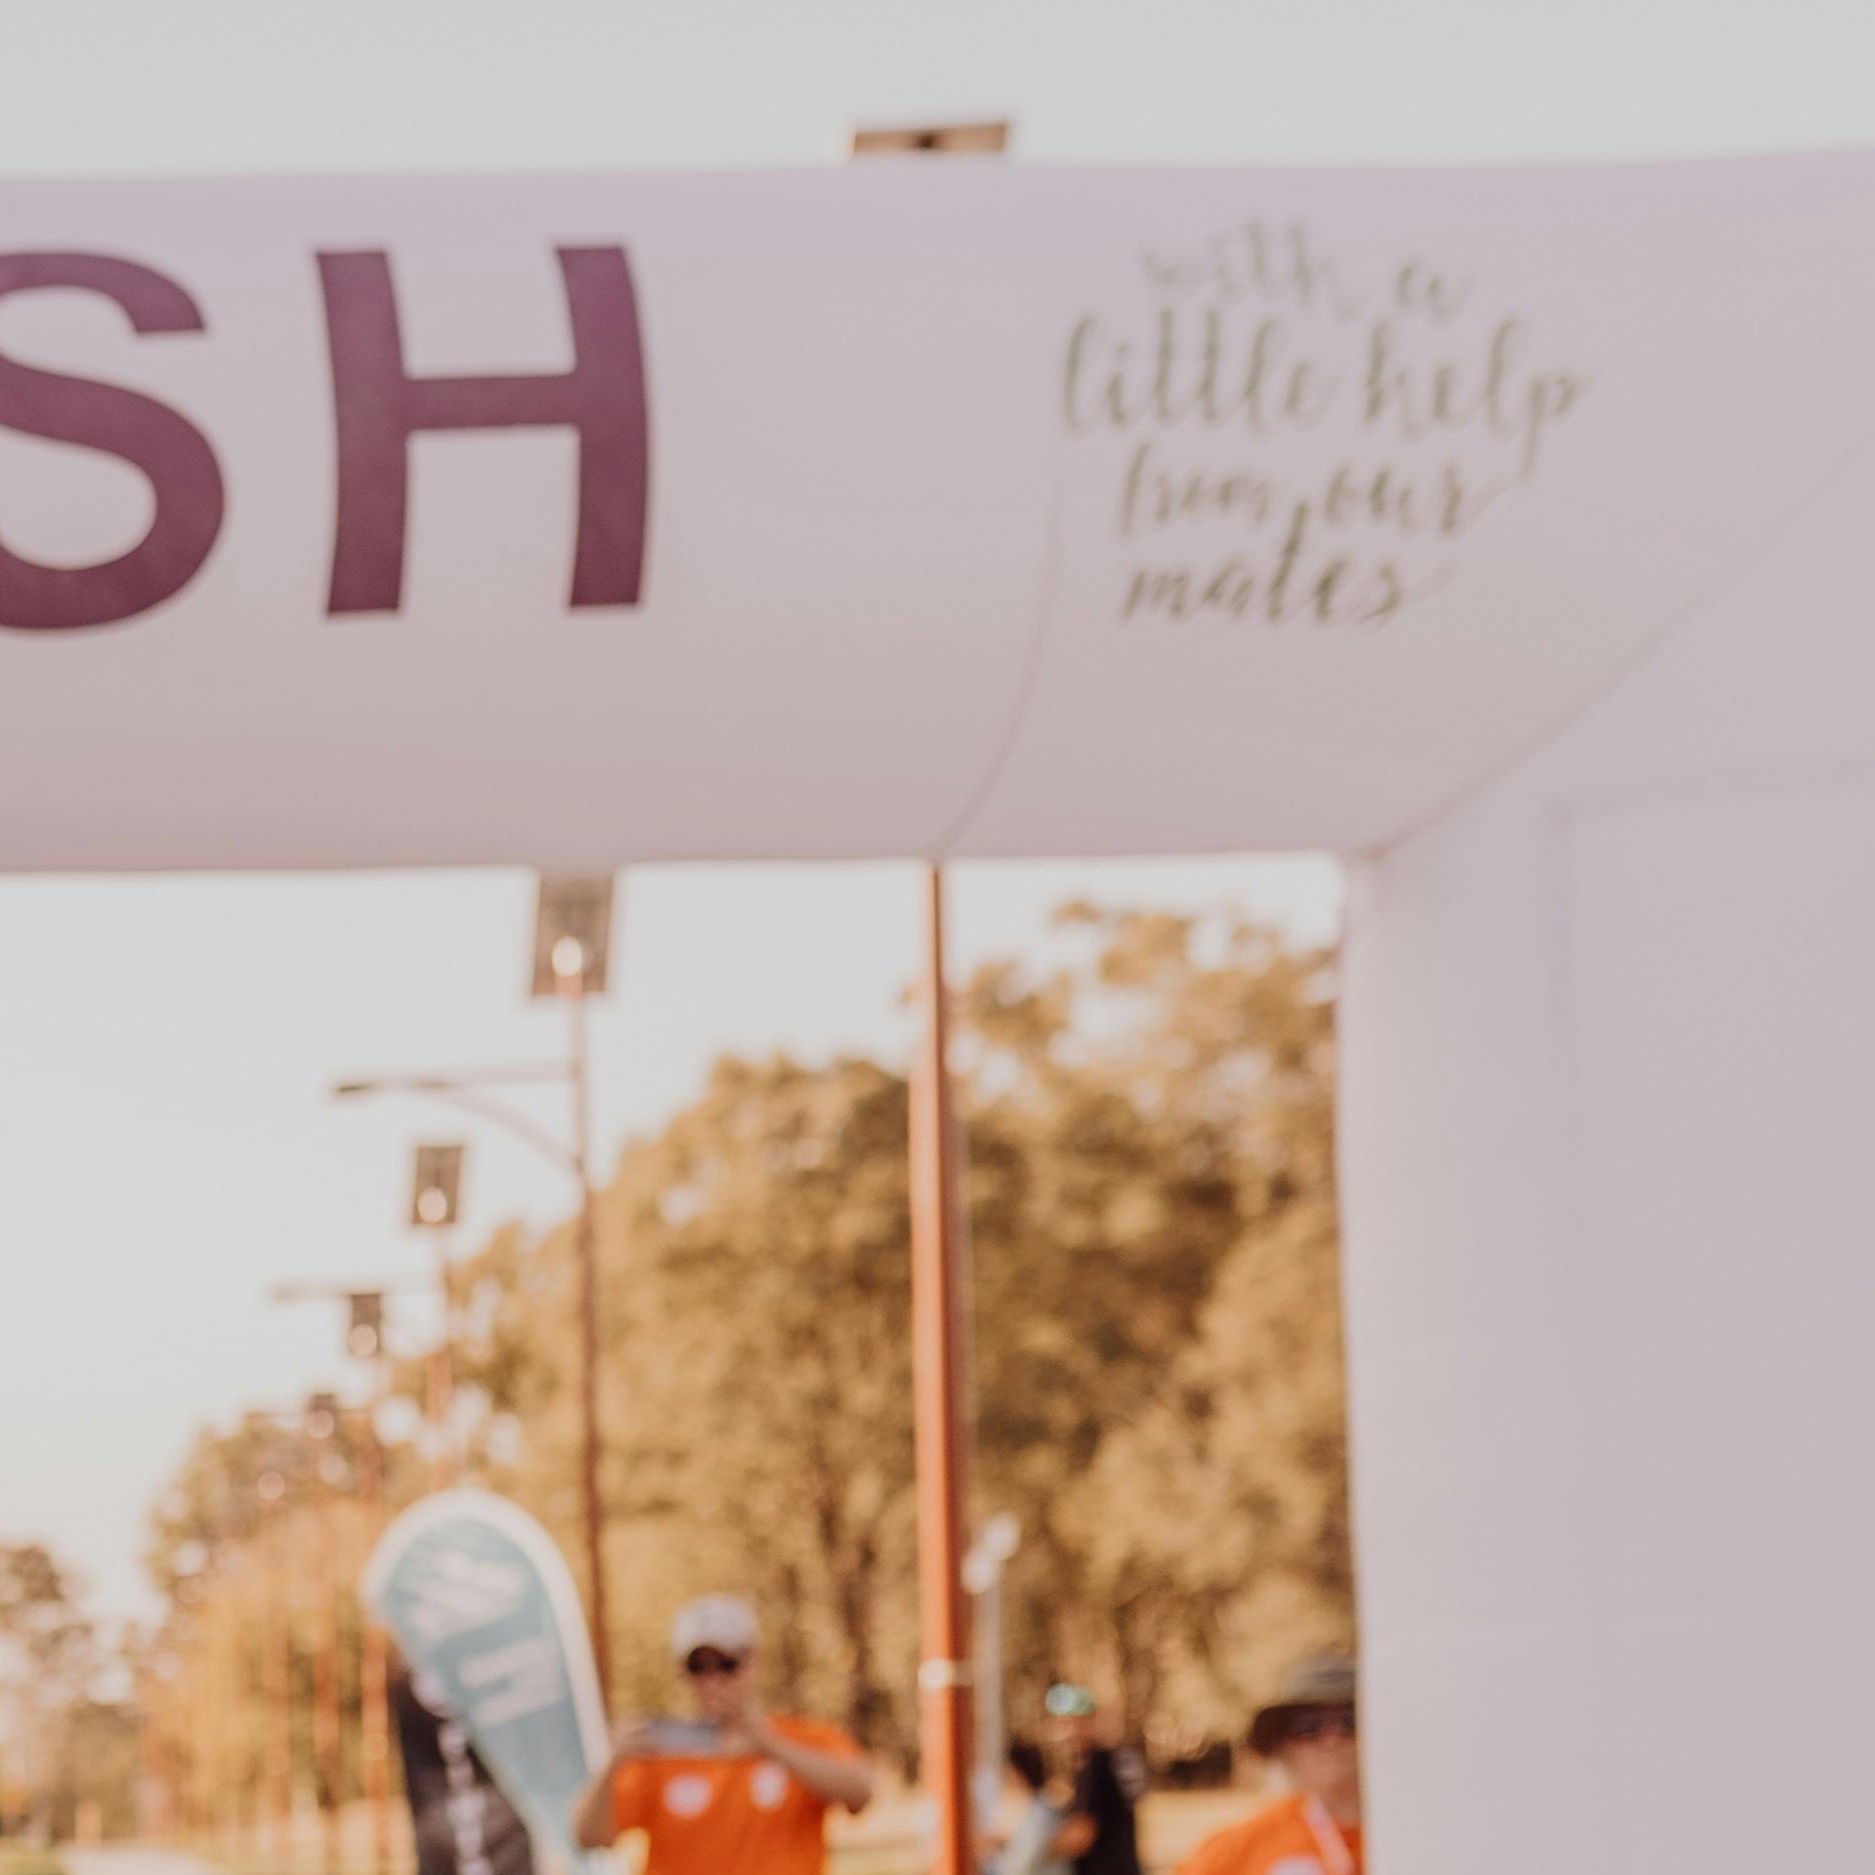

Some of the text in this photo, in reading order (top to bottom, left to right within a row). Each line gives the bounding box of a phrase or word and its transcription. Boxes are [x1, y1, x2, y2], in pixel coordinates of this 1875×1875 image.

[1134, 214, 1473, 321] with a
[1061, 308, 1597, 481] little help
[1117, 437, 1274, 539] from
[1120, 498, 1440, 627] mates
